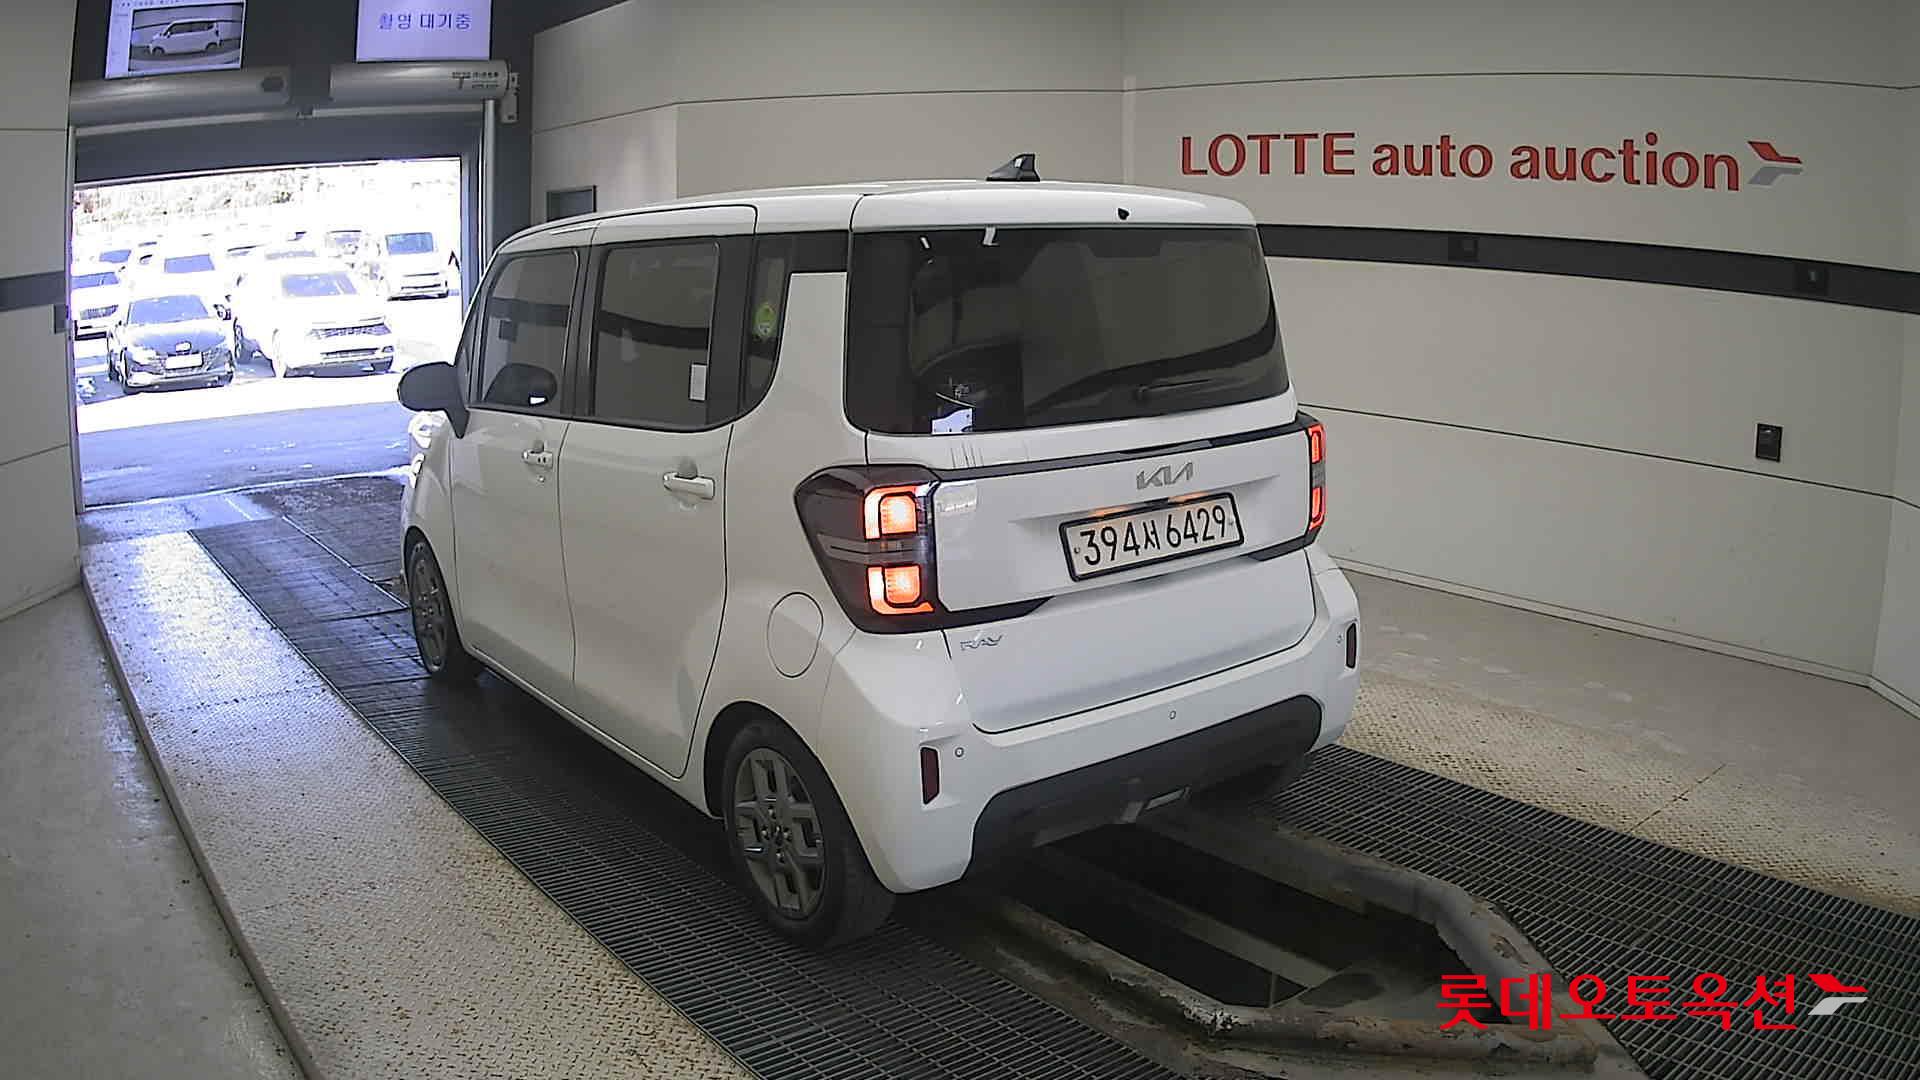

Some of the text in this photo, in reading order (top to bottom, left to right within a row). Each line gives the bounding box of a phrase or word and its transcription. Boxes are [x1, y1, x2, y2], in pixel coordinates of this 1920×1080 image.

[420, 12, 472, 30] 대기중
[1182, 131, 1740, 193] LOTTE auto auction
[1136, 461, 1194, 490] KIA
